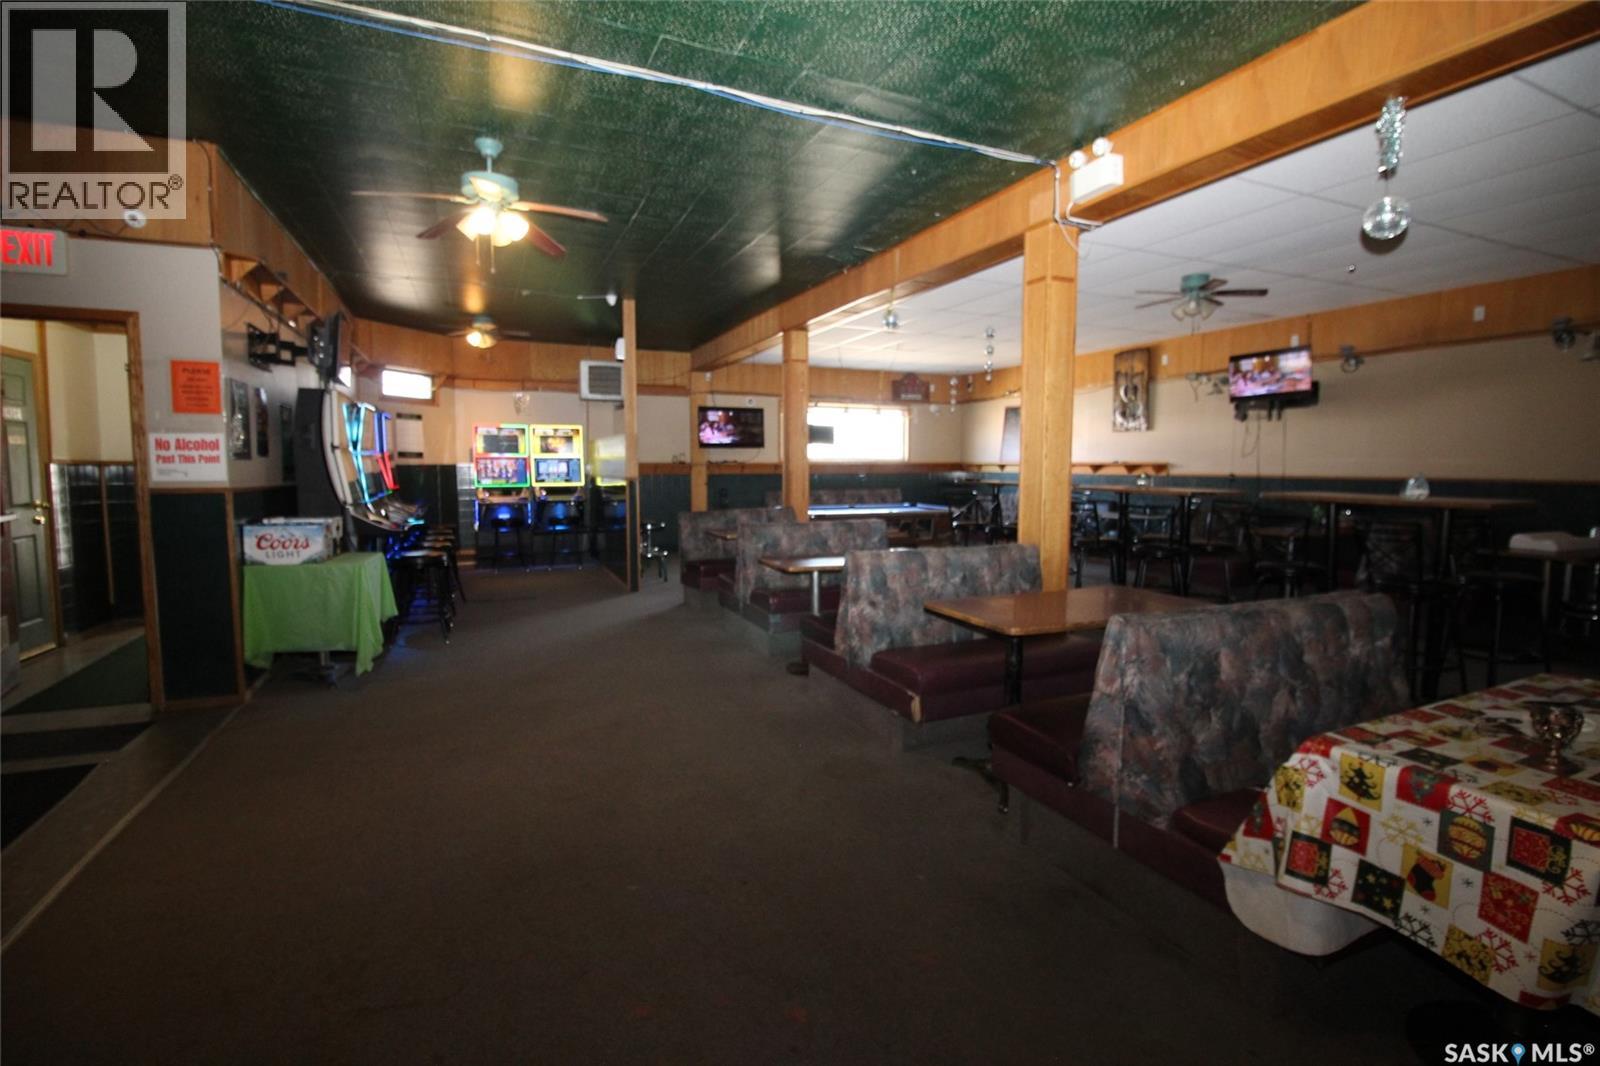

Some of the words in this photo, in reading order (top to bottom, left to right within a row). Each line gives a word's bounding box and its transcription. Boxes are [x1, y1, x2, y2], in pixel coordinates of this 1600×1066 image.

[1, 230, 56, 266] EXIT
[155, 437, 171, 451] No
[175, 437, 220, 451] Alcohol
[155, 454, 175, 465] Past
[178, 454, 196, 465] This
[198, 454, 221, 465] Point
[256, 533, 310, 550] Coors
[265, 550, 301, 559] LIGHT
